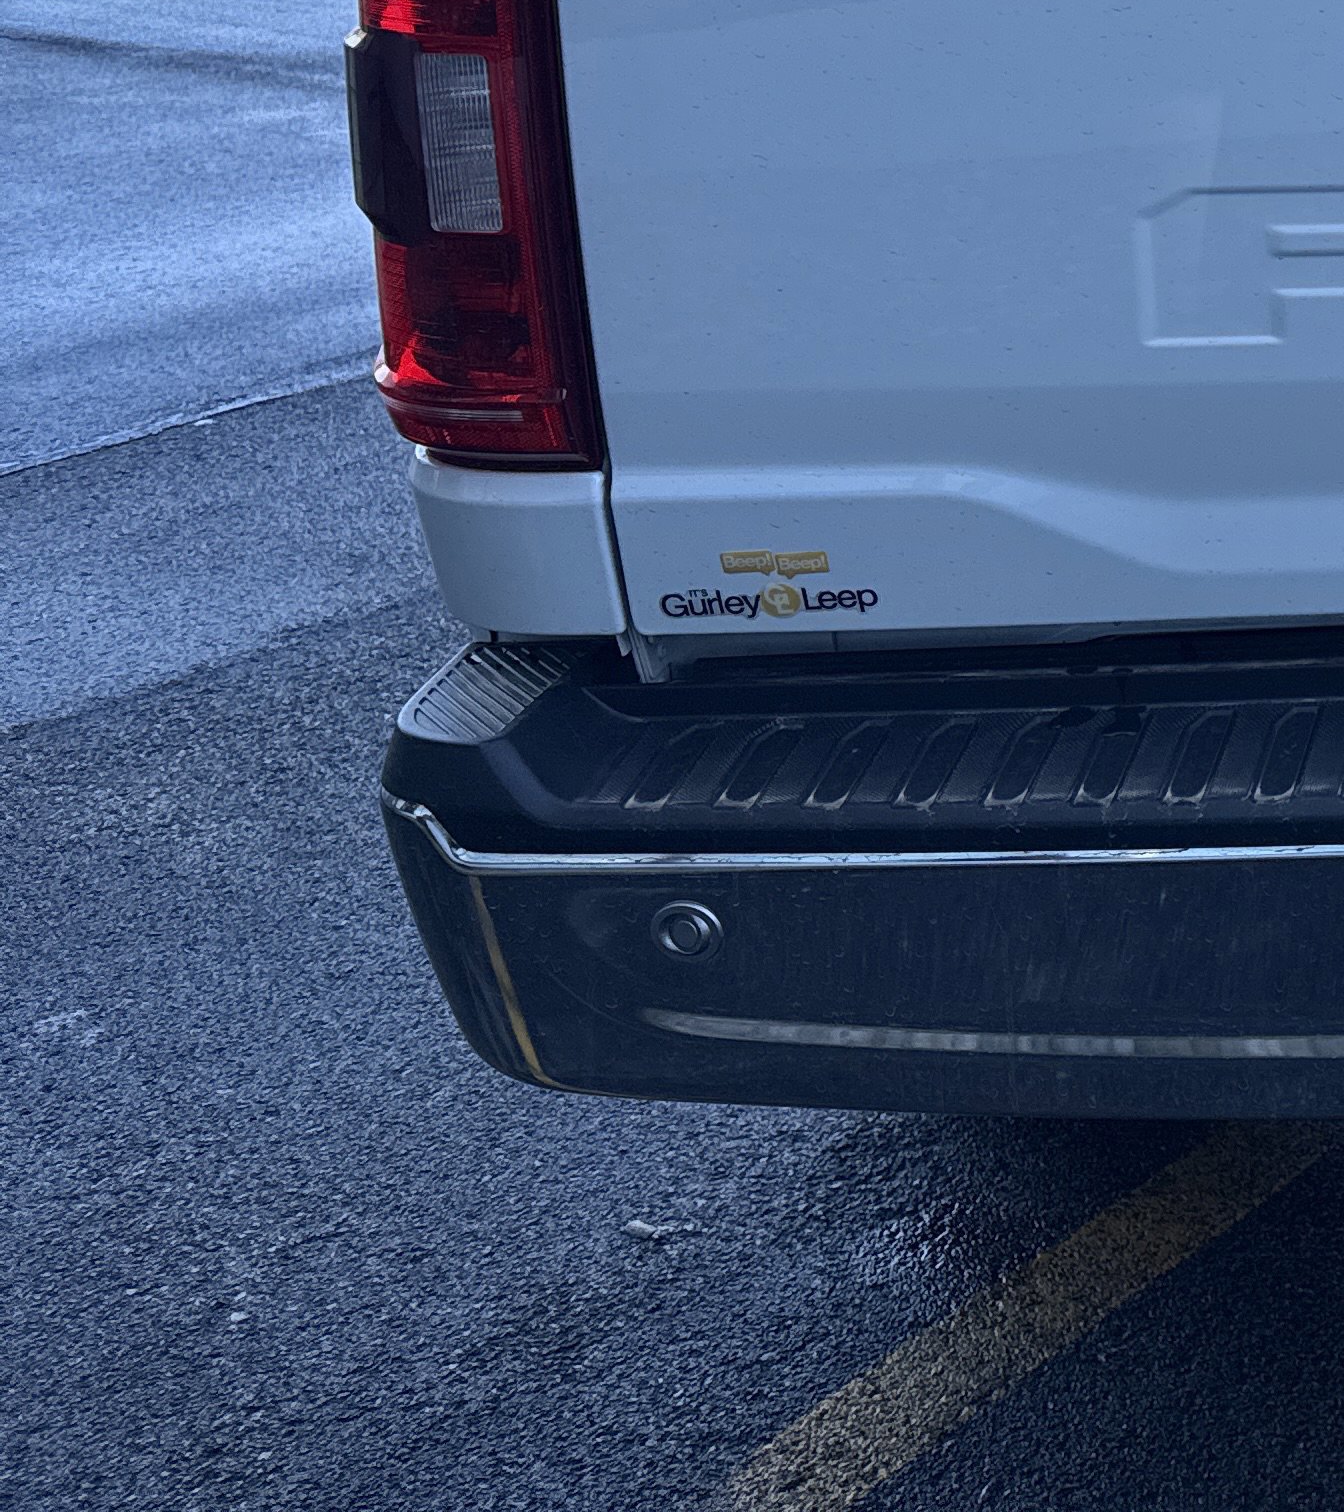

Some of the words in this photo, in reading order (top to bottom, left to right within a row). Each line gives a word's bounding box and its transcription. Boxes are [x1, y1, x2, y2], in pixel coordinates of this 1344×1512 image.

[723, 553, 770, 569] Beep!
[778, 554, 825, 571] Beep!
[661, 590, 761, 618] Gurley
[800, 588, 878, 612] Leep
